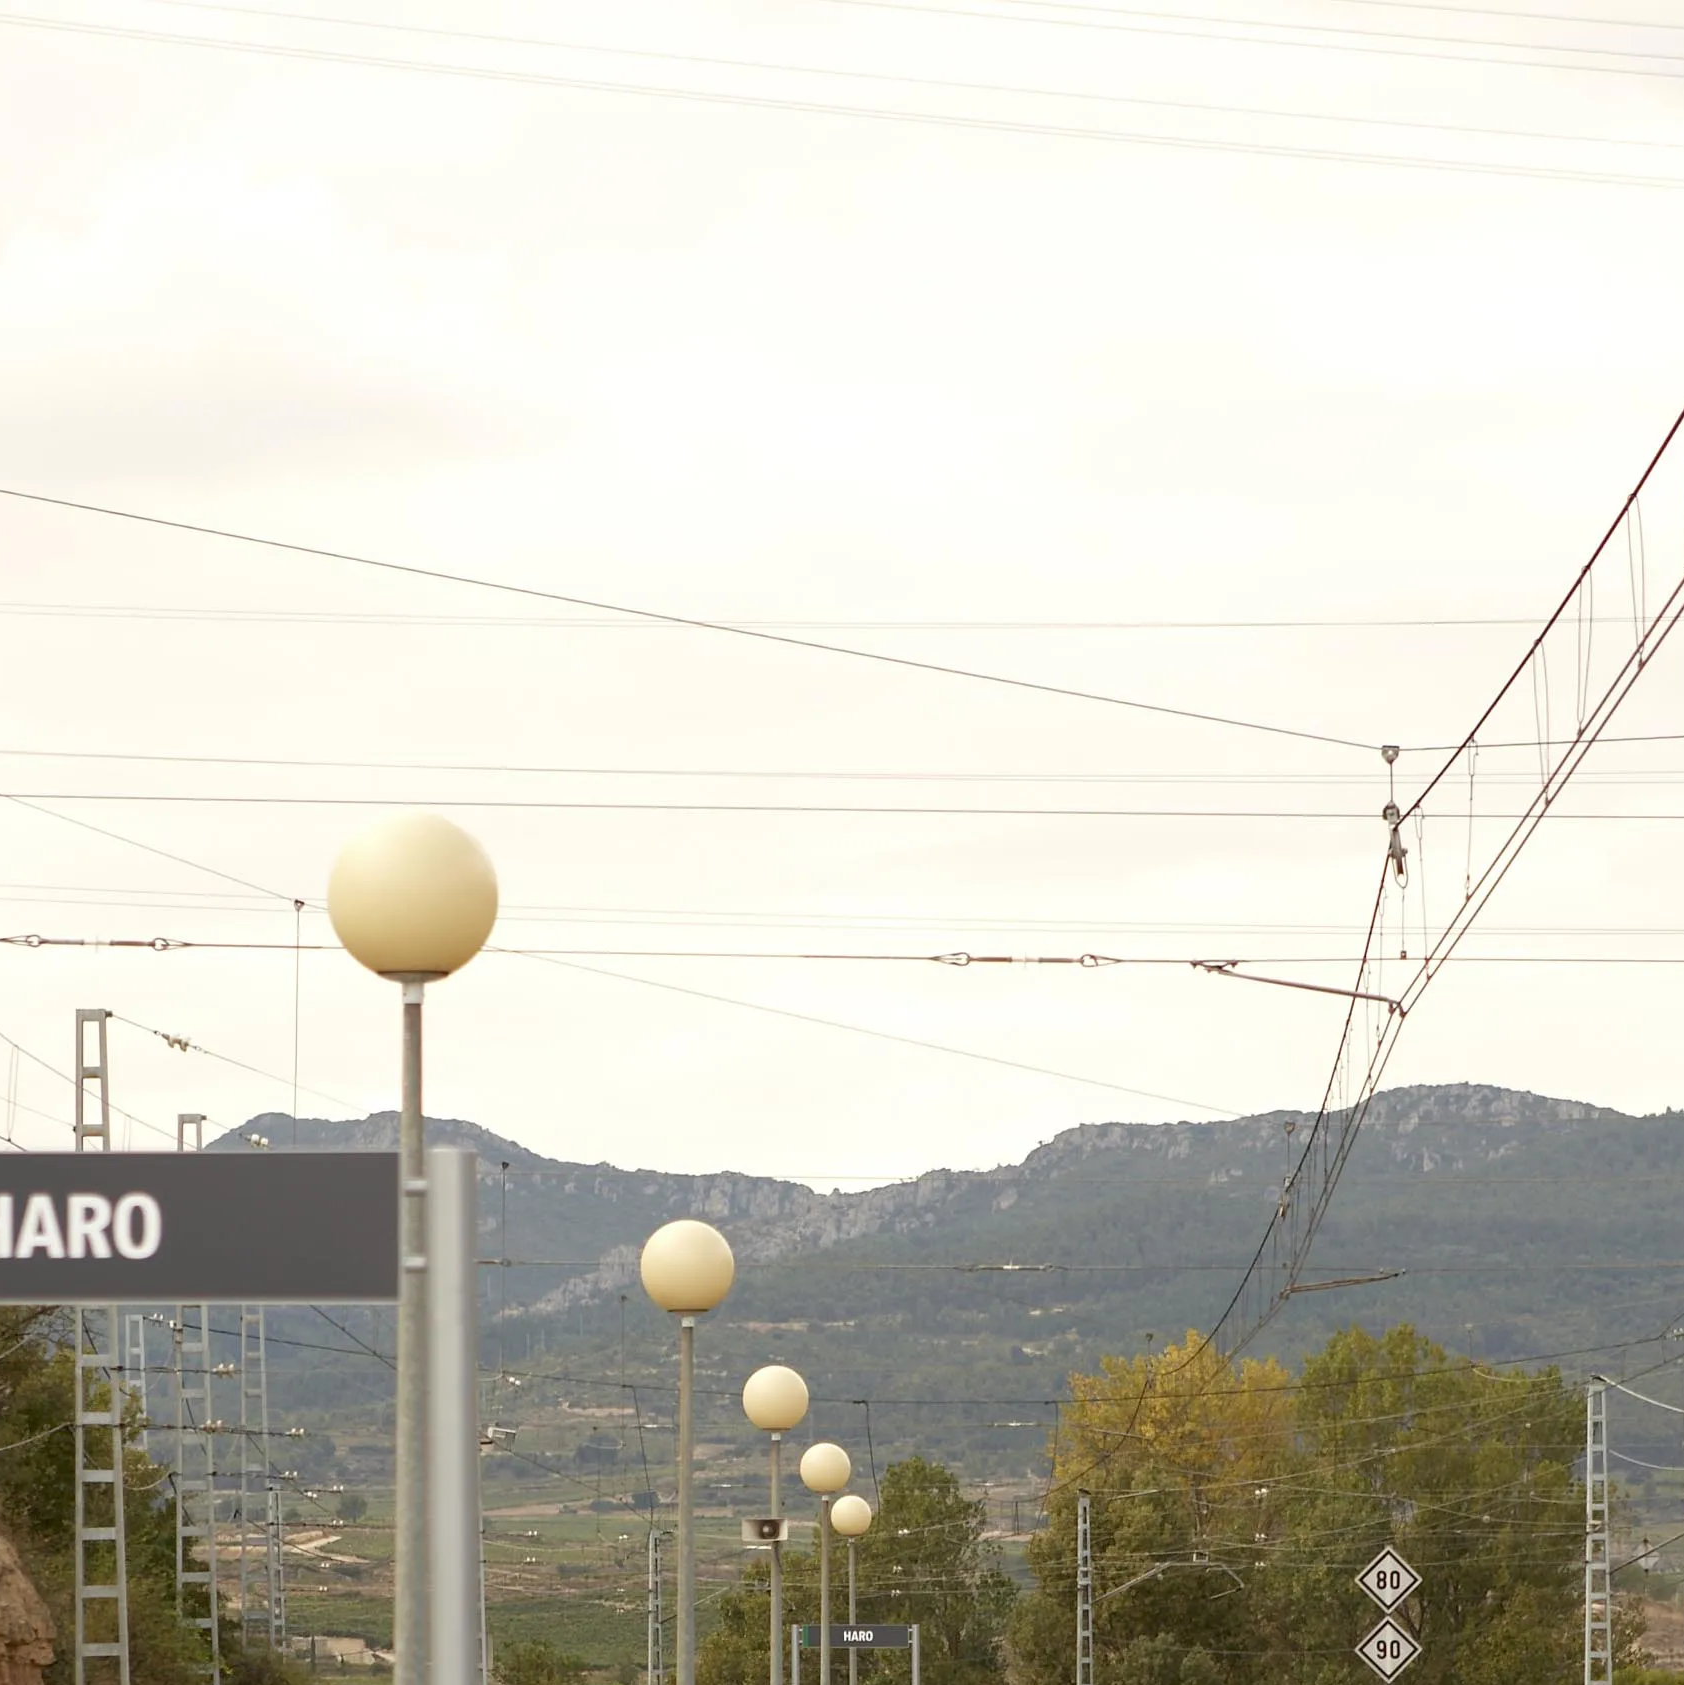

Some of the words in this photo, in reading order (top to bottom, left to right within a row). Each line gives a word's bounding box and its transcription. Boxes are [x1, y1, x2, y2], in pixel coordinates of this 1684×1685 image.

[1376, 1570, 1401, 1590] 80
[843, 1630, 874, 1642] HARO
[1376, 1640, 1401, 1660] 90
